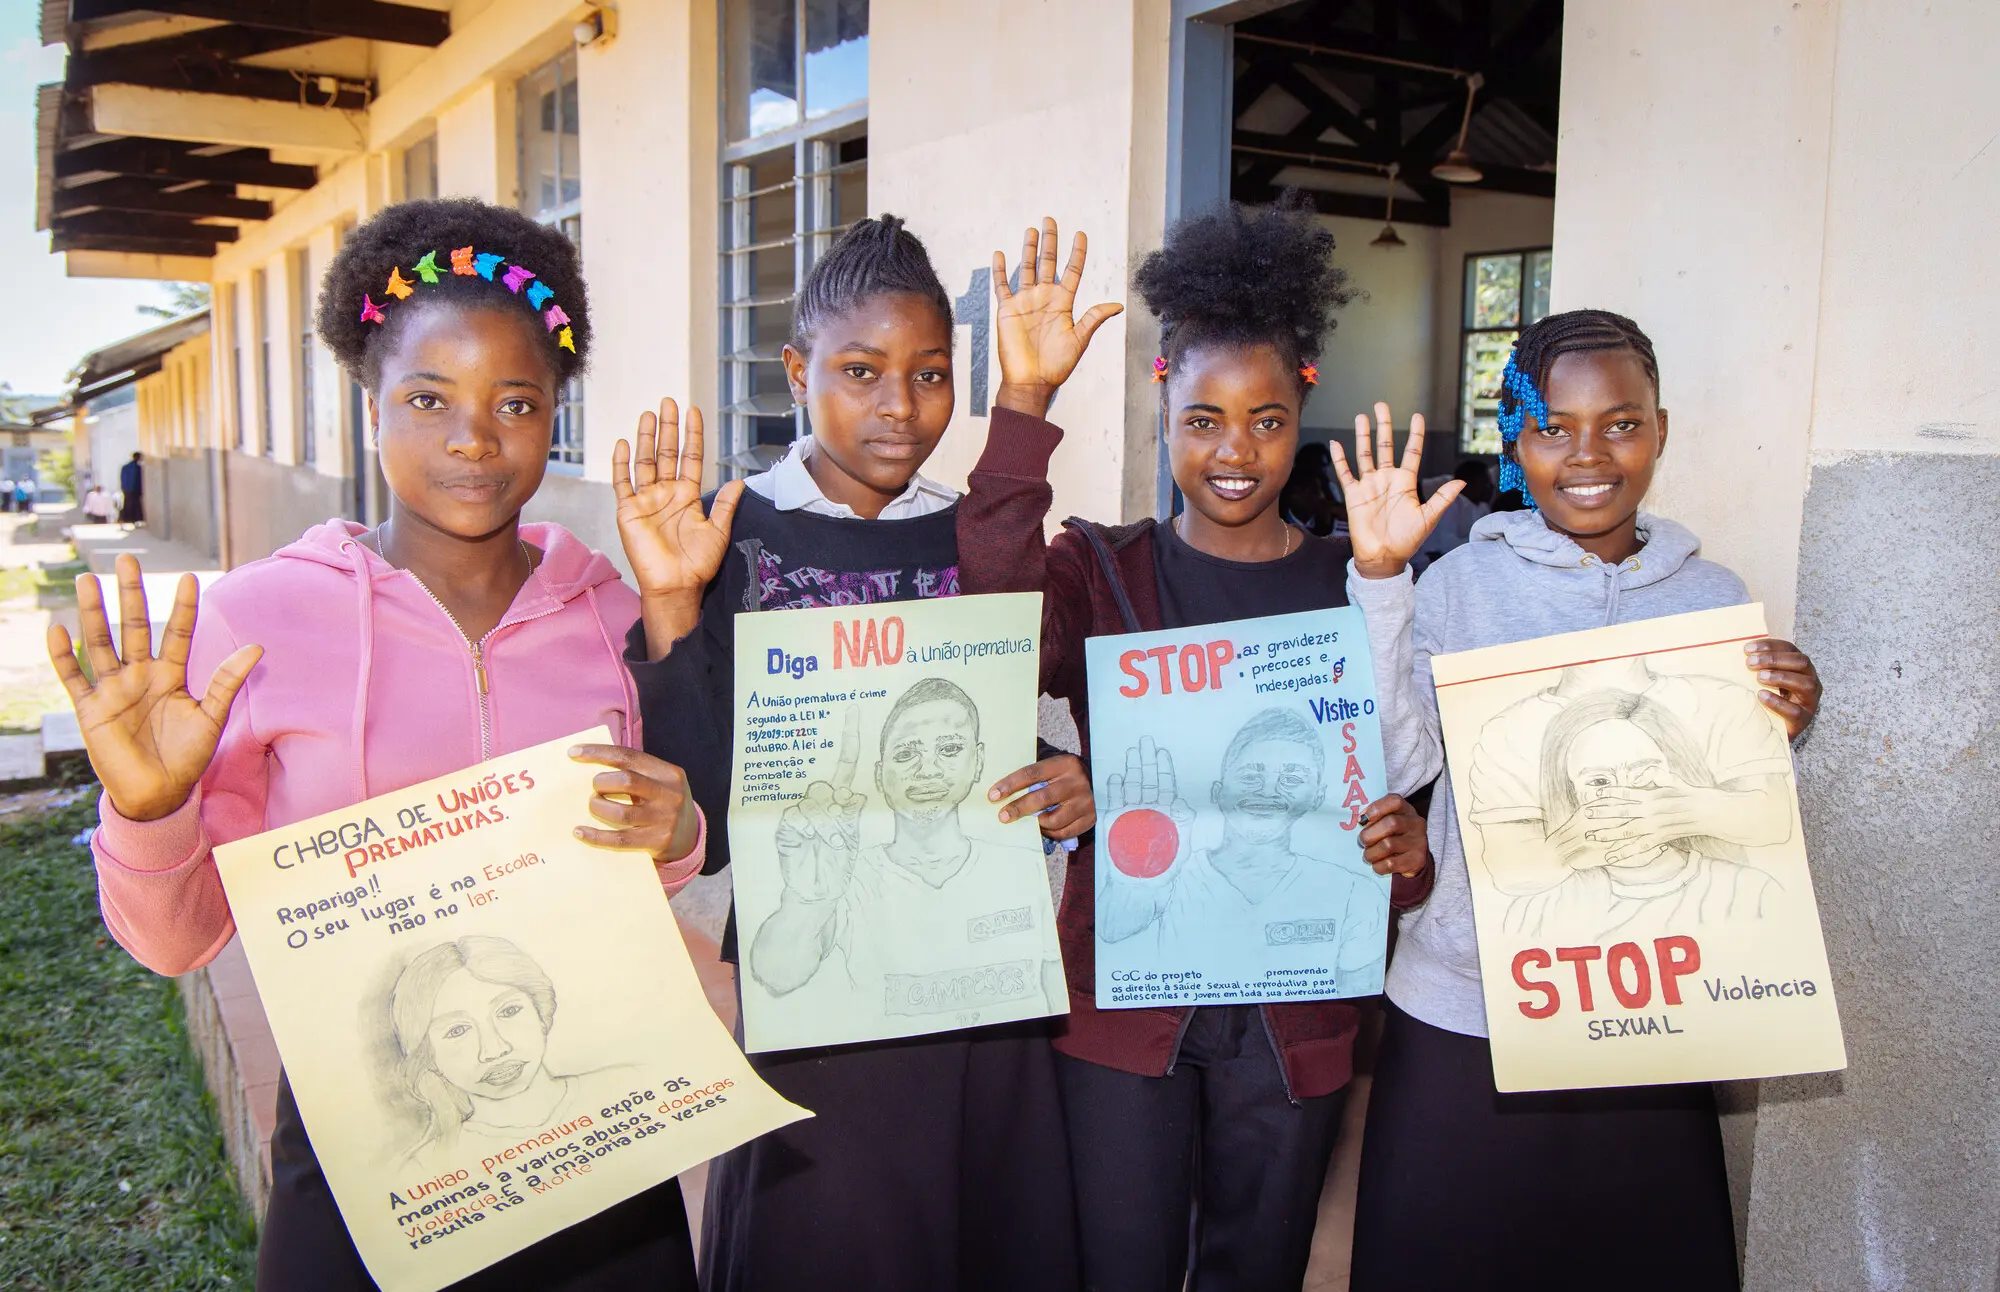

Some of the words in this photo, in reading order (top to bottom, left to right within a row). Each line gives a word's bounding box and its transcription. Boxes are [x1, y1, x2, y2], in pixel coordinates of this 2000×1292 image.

[1267, 631, 1339, 658] gravidezes
[767, 648, 819, 680] Diga
[963, 638, 1035, 665] prematura.
[1252, 655, 1311, 679] precoces
[747, 691, 760, 708] A
[794, 692, 847, 708] prematura
[849, 689, 857, 700] é
[1308, 697, 1360, 724] Visite
[746, 713, 787, 728] segundo
[789, 713, 797, 722] a
[800, 710, 815, 721] LEI
[820, 739, 834, 749] de
[743, 769, 793, 781] combate
[795, 768, 807, 779] às
[744, 756, 804, 772] prevenção
[396, 803, 432, 830] DE
[277, 873, 382, 926] Rapariga!!
[286, 929, 308, 949] O
[313, 917, 350, 940] seu
[360, 893, 417, 922] lugar
[429, 883, 443, 900] é
[450, 875, 476, 894] na
[388, 911, 427, 935] não
[434, 903, 459, 921] no
[1111, 969, 1141, 981] CoC
[1144, 971, 1158, 981] do
[1161, 970, 1203, 983] projeto
[1265, 967, 1329, 980] promovendo
[1111, 985, 1123, 993] os
[1125, 983, 1161, 993] direitos
[1173, 982, 1202, 991] saúde
[1252, 979, 1308, 989] reprodutiva
[1312, 978, 1335, 988] para
[1511, 935, 1701, 1020] STOP
[1703, 975, 1818, 1002] Violência
[1112, 991, 1179, 1002] adolescentes
[1193, 992, 1221, 1001] jovens
[1223, 990, 1238, 998] em
[1240, 989, 1262, 998] toda
[1266, 990, 1282, 998] sua
[1588, 1015, 1685, 1042] SEXUAL
[389, 1191, 408, 1210] A
[600, 1091, 656, 1119] expõe
[663, 1076, 691, 1093] as
[525, 1174, 541, 1187] a
[552, 1136, 632, 1175] maioria
[634, 1120, 666, 1140] das
[671, 1093, 728, 1122] vezes
[397, 1181, 490, 1226] meninas
[496, 1171, 513, 1183] a
[516, 1142, 581, 1174] varios
[582, 1112, 652, 1147] abusos
[409, 1212, 486, 1250] resulta
[492, 1194, 525, 1212] na
